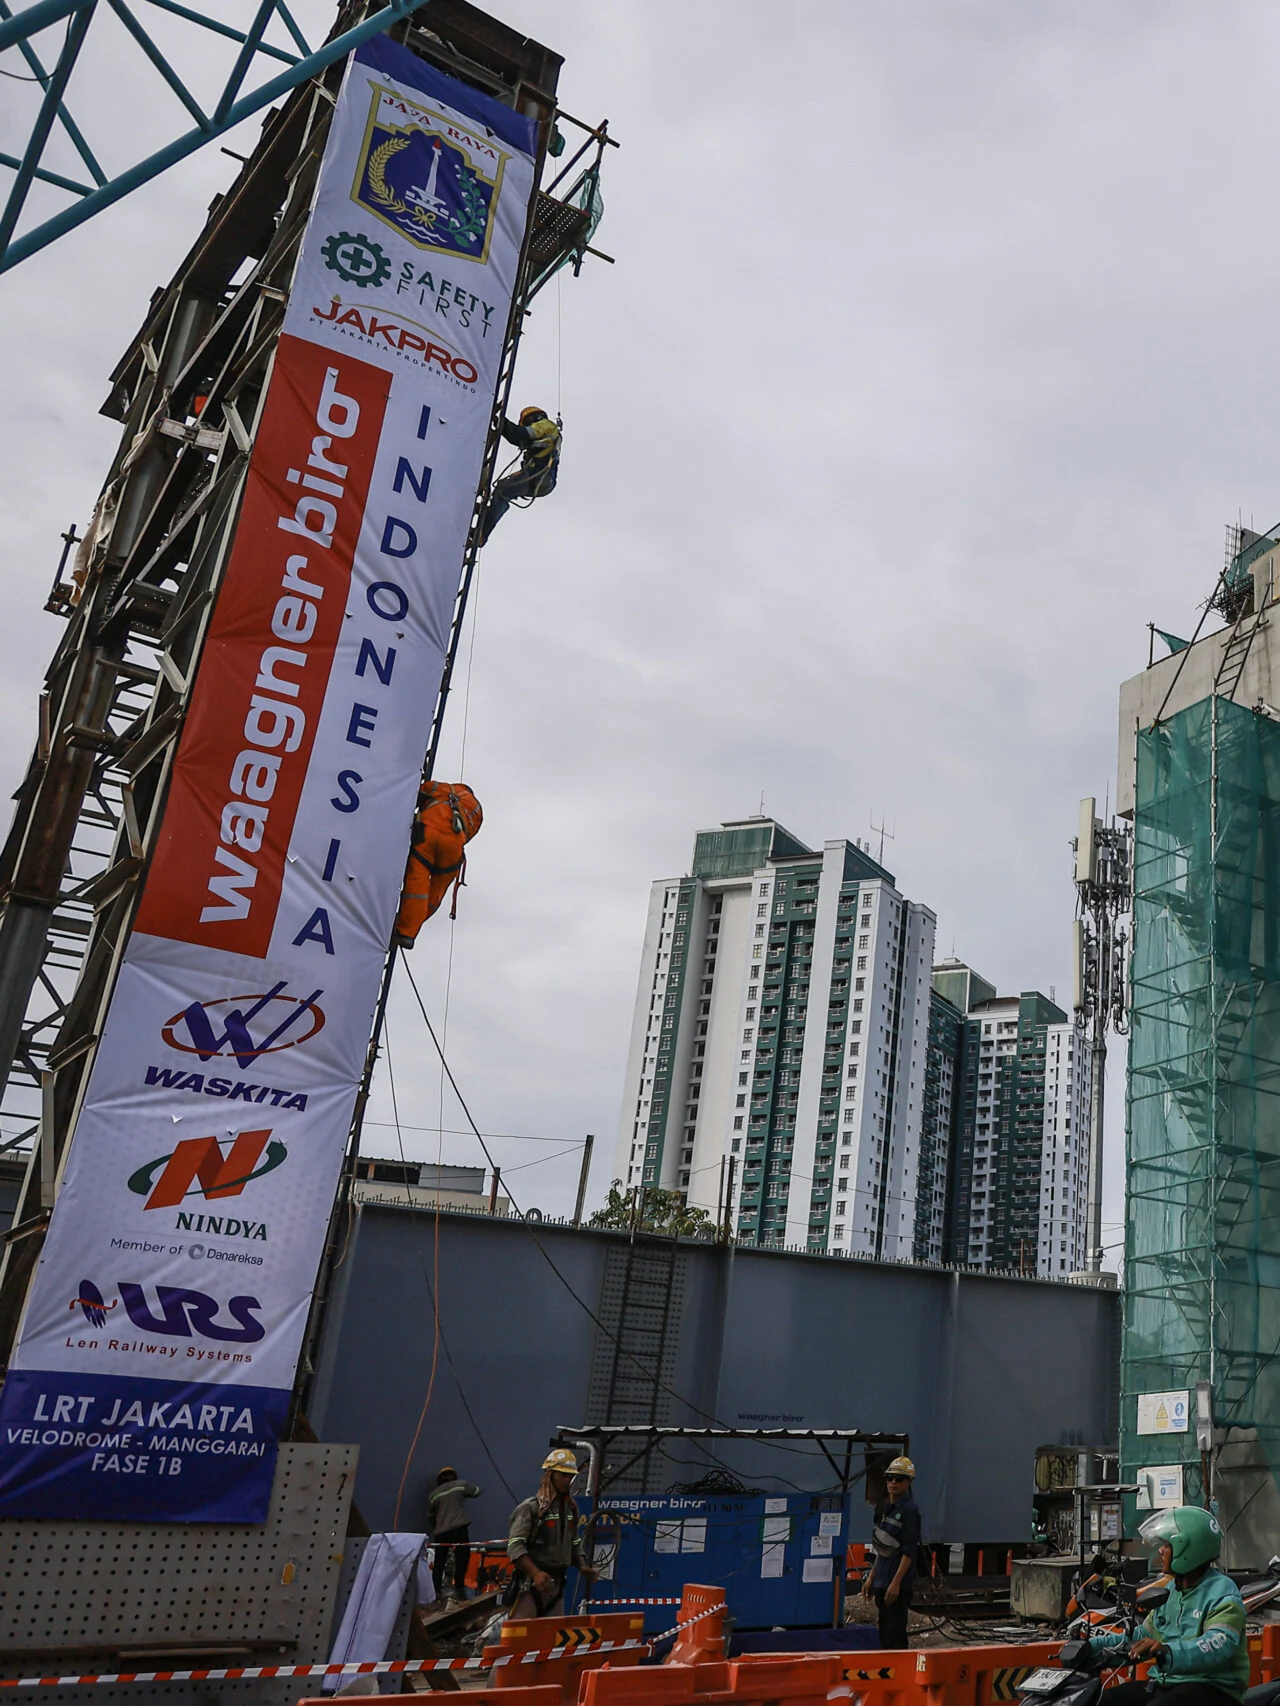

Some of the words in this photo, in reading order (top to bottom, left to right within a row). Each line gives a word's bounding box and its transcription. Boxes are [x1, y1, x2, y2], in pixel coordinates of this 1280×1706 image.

[382, 96, 432, 126] JAYA
[447, 127, 497, 160] RAYA
[396, 282, 491, 337] FIRST
[400, 262, 494, 319] SAFETY
[312, 297, 478, 384] JAKPRO
[332, 326, 388, 352] JAKARTA
[396, 350, 476, 395] PROPERTINDO
[292, 404, 433, 956] INDONESIA
[200, 554, 328, 924] waagner
[144, 1065, 309, 1112] WASKITA
[175, 1212, 269, 1241] NINDYA
[110, 1237, 166, 1255] Member
[169, 1243, 184, 1256] of
[206, 1247, 264, 1266] Danareksa
[66, 1337, 98, 1351] Len
[108, 1339, 179, 1359] Railway
[186, 1346, 253, 1364] Systems
[33, 1394, 95, 1424] LRT
[101, 1398, 255, 1434] JAKARTA
[7, 1428, 131, 1450] VELODROME
[149, 1434, 266, 1457] MANGGARAI
[91, 1453, 149, 1475] FASE
[158, 1456, 183, 1476] 1B
[598, 1498, 667, 1511] waagner
[1197, 1632, 1228, 1654] Grab
